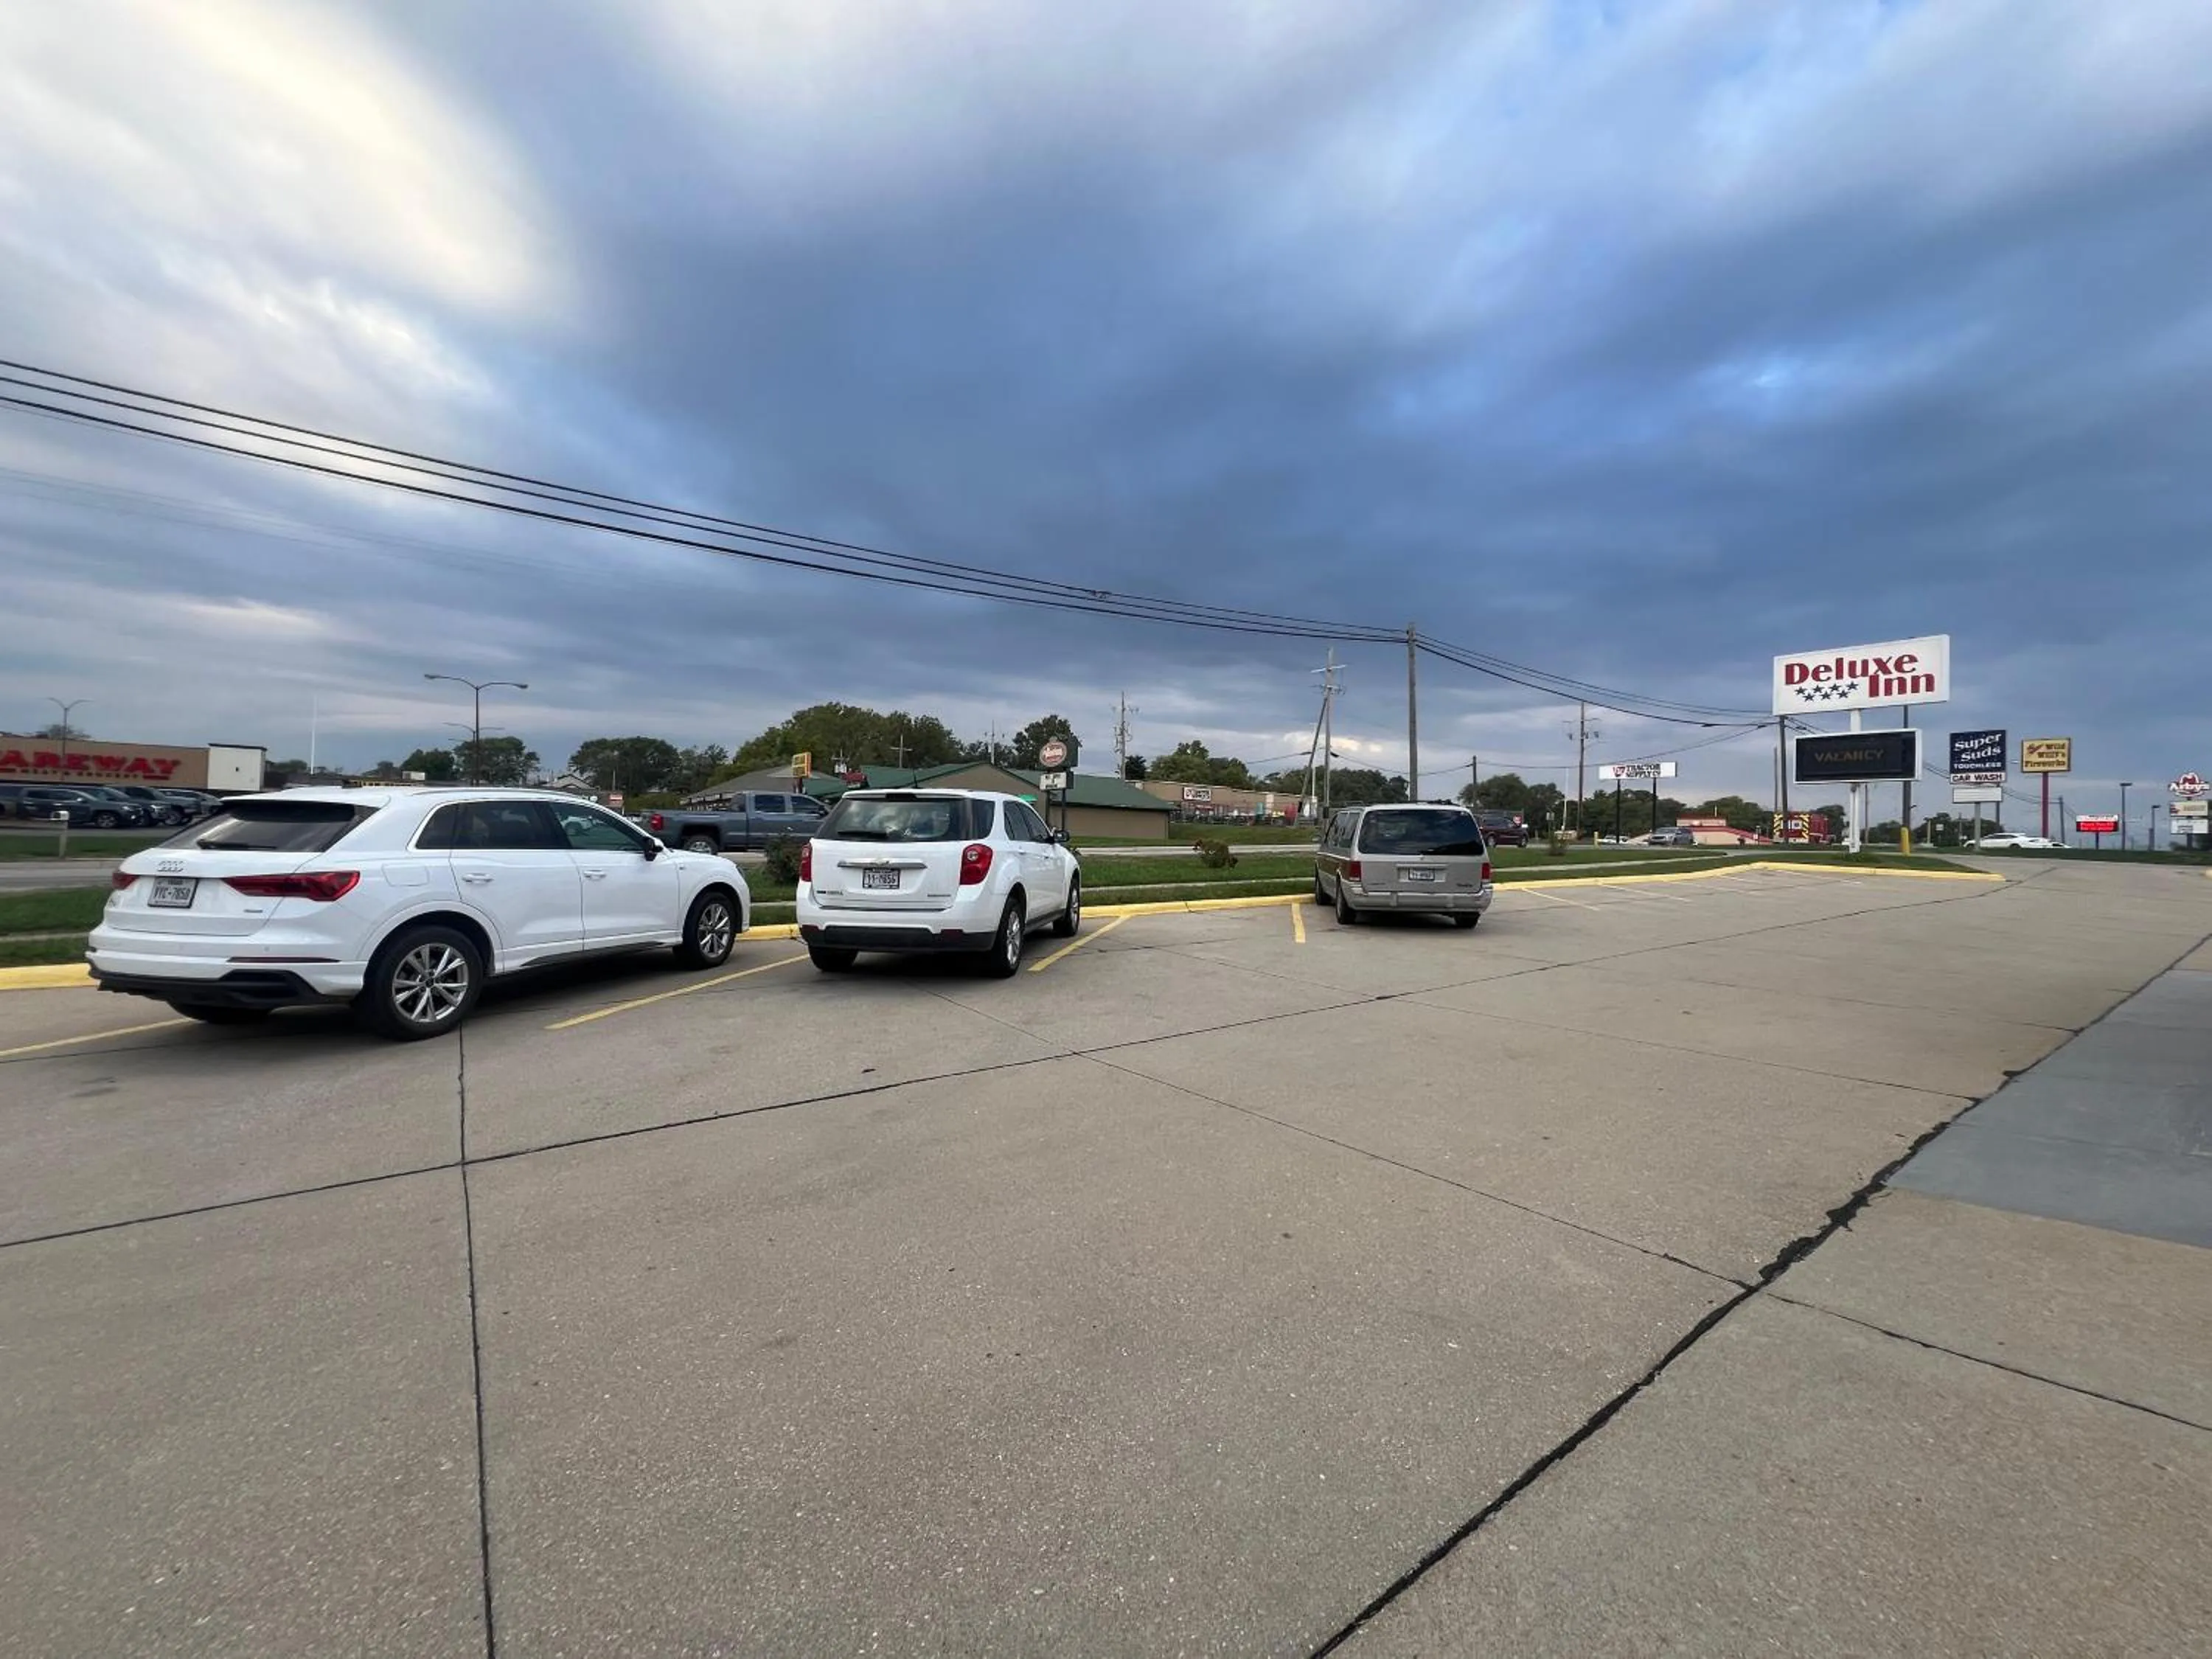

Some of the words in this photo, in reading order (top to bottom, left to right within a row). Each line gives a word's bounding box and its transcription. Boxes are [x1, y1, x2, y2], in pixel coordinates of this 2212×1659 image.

[1784, 654, 1919, 686] Deluxe
[1868, 672, 1935, 698] Inn
[1952, 734, 2002, 751] Super
[0, 750, 181, 774] AREWAY
[1814, 748, 1885, 763] VACANCY
[1961, 745, 2002, 762] Suds
[1952, 774, 1971, 782] CAR
[1974, 773, 2003, 782] WASH
[2169, 781, 2210, 792] Arby's
